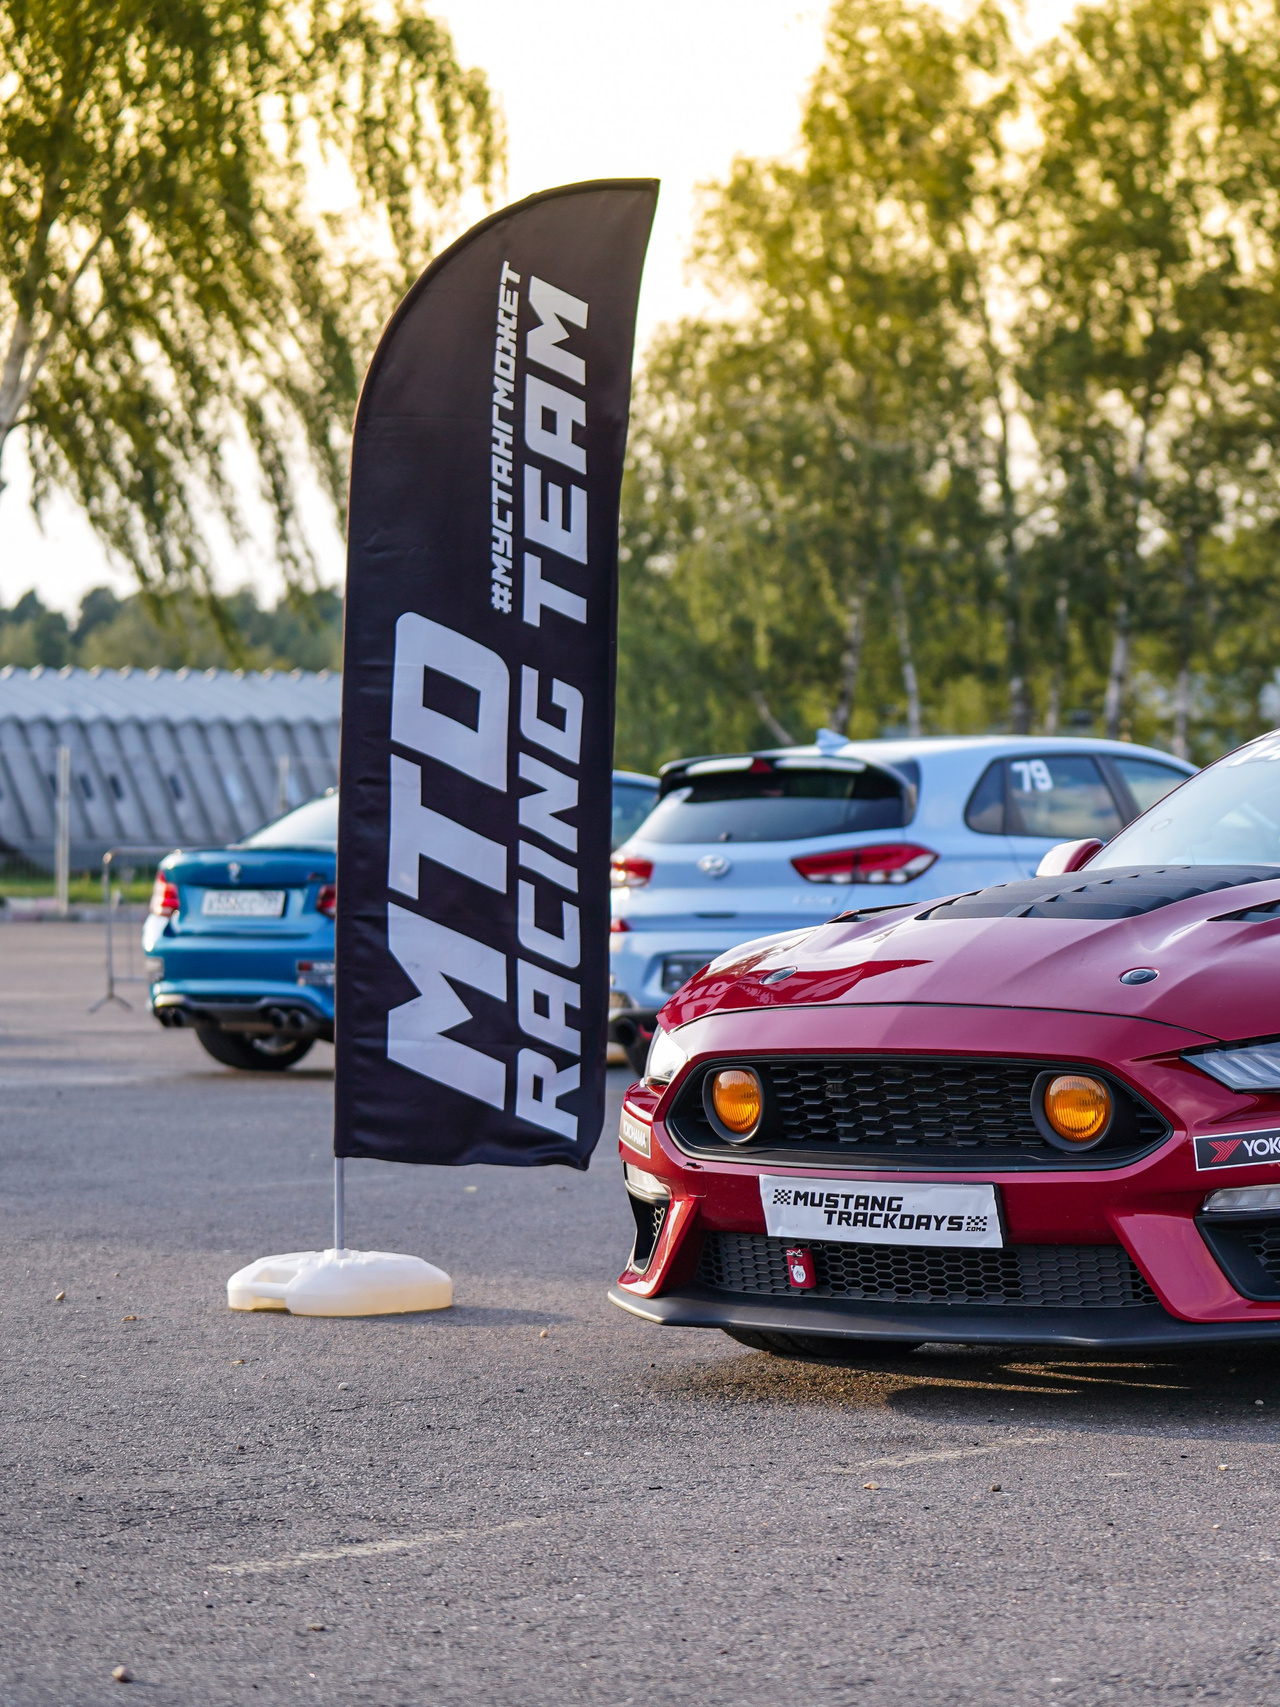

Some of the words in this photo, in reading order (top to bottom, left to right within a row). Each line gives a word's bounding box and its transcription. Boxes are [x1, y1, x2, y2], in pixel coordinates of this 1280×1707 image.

[490, 260, 521, 615] #МУСТАНГМОЖЕТ
[522, 275, 589, 628] TEAM
[387, 611, 511, 1111] MTD
[515, 664, 584, 1141] RACING
[1011, 759, 1053, 792] 79
[792, 1190, 904, 1212] MUSTANG
[823, 1209, 965, 1232] TRACKDAYS
